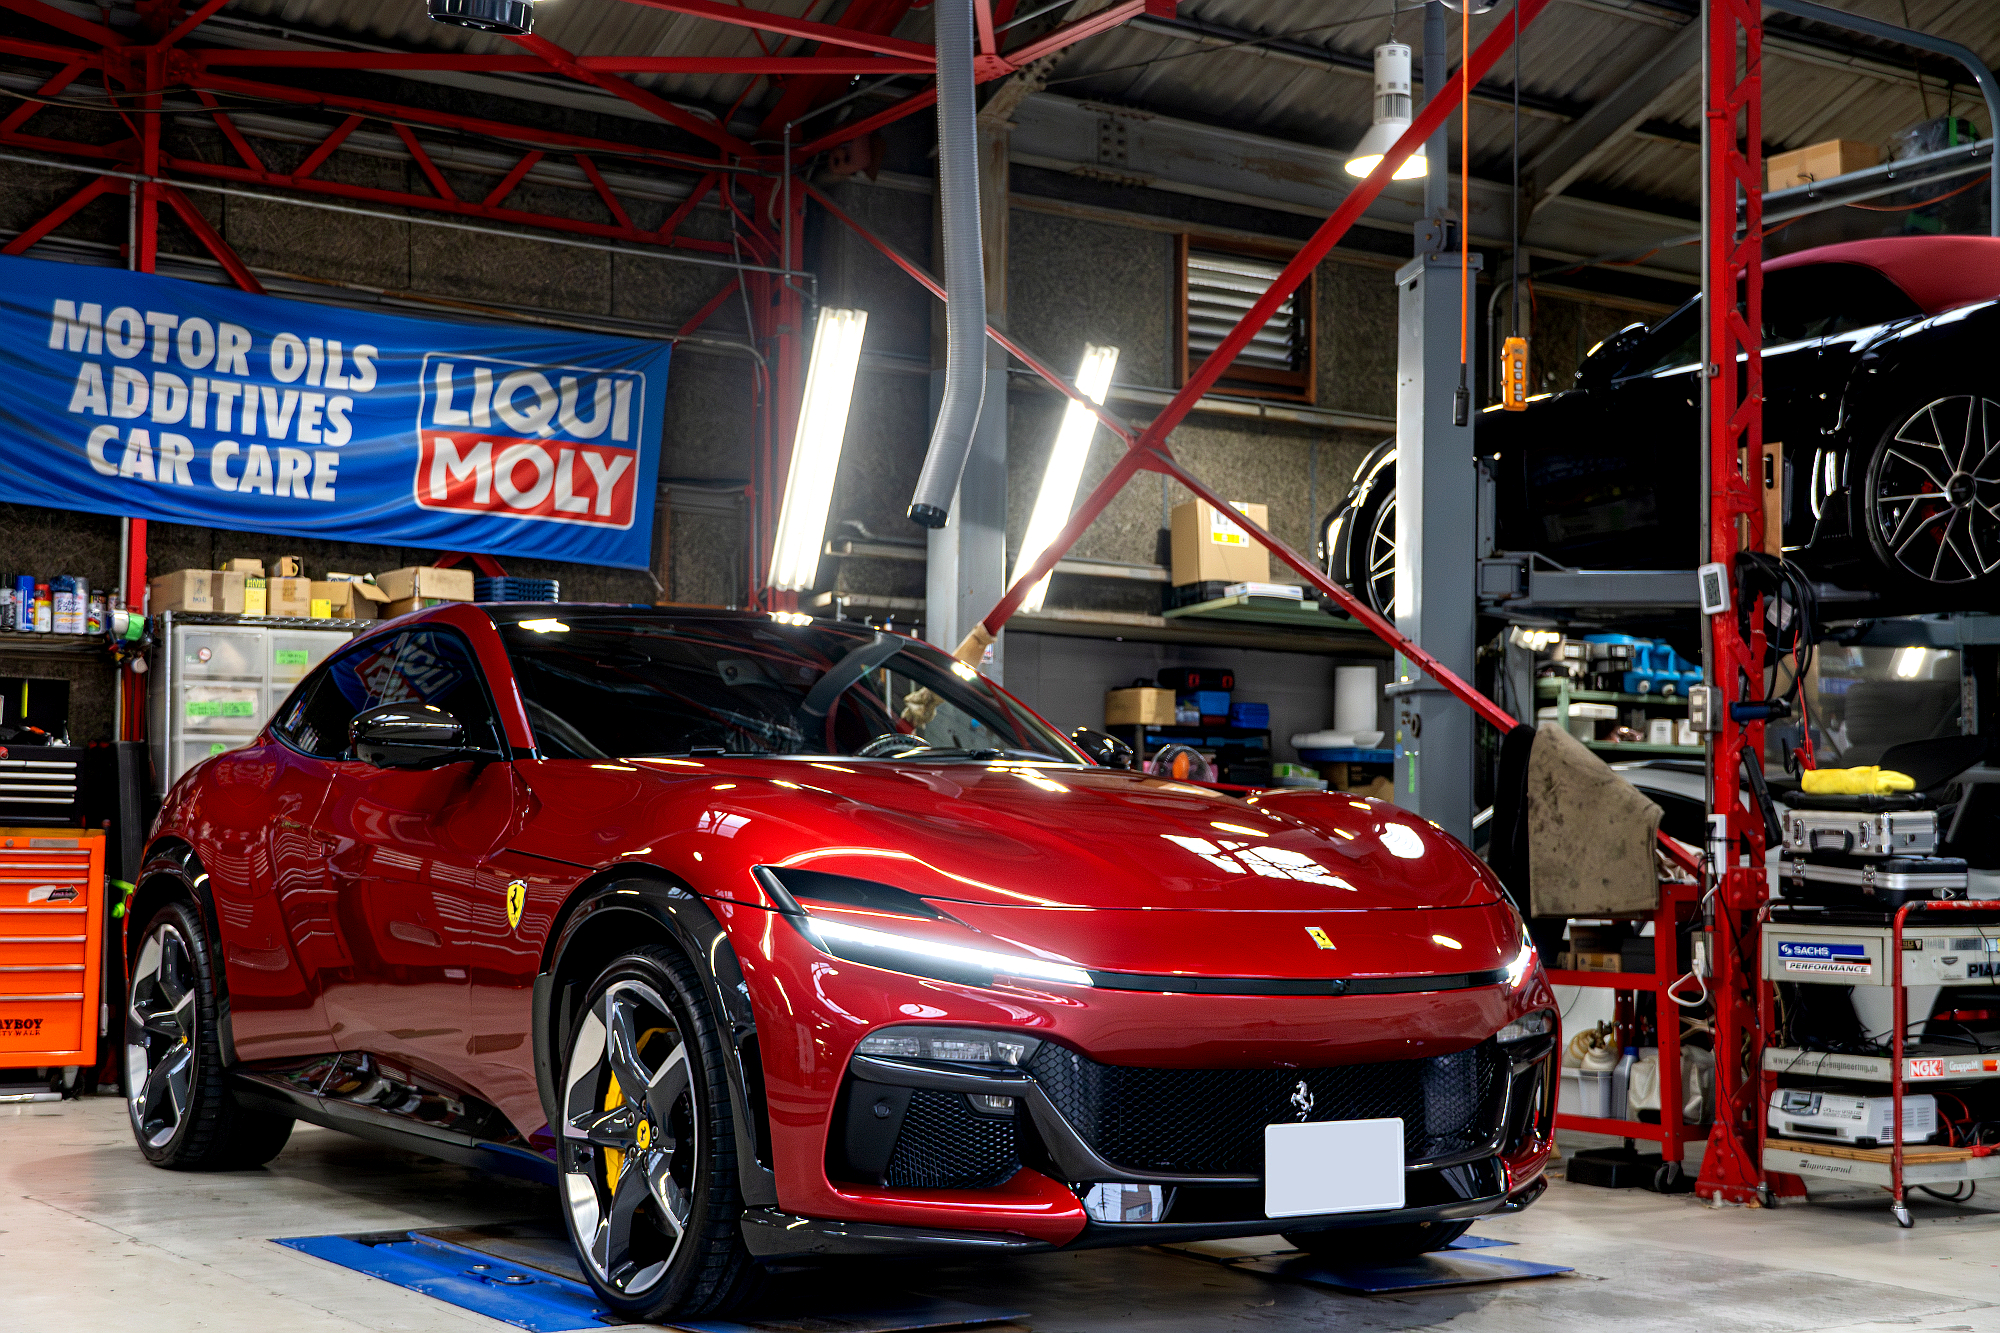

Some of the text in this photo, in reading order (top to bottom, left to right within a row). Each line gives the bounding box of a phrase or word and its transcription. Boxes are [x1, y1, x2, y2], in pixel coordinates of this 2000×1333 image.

[48, 299, 379, 393] MOTOR OILS
[68, 361, 354, 447] ADDITIVES
[432, 362, 634, 442] LIQUI
[86, 424, 340, 502] CAR CARE
[428, 440, 635, 518] MOLY
[1789, 962, 1867, 973] PERFORMANCE
[1793, 946, 1830, 957] SACHS
[1910, 1060, 1939, 1076] NGK
